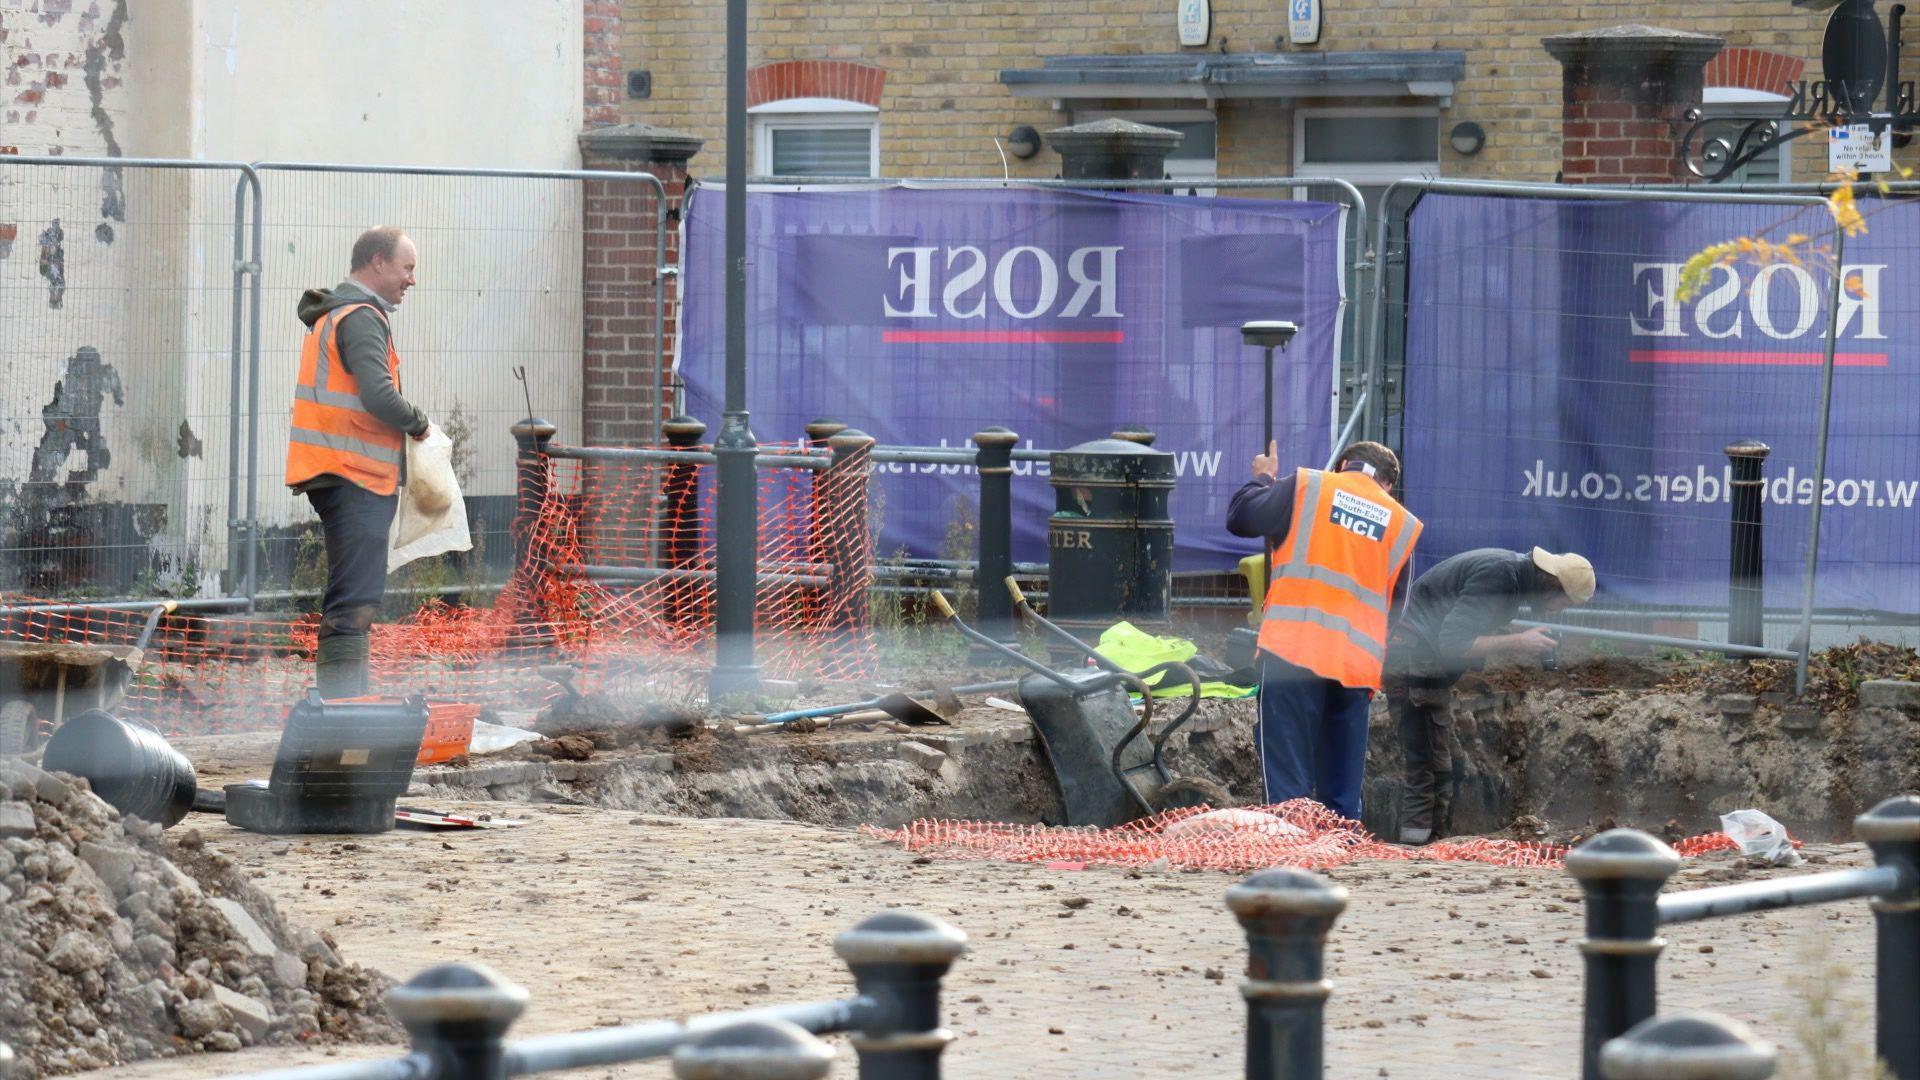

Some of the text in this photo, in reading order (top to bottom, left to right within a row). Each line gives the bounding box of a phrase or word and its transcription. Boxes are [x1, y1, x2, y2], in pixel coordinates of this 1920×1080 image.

[1336, 491, 1389, 518] Archaeology
[1338, 500, 1384, 522] South-East
[1339, 512, 1378, 541] UCL
